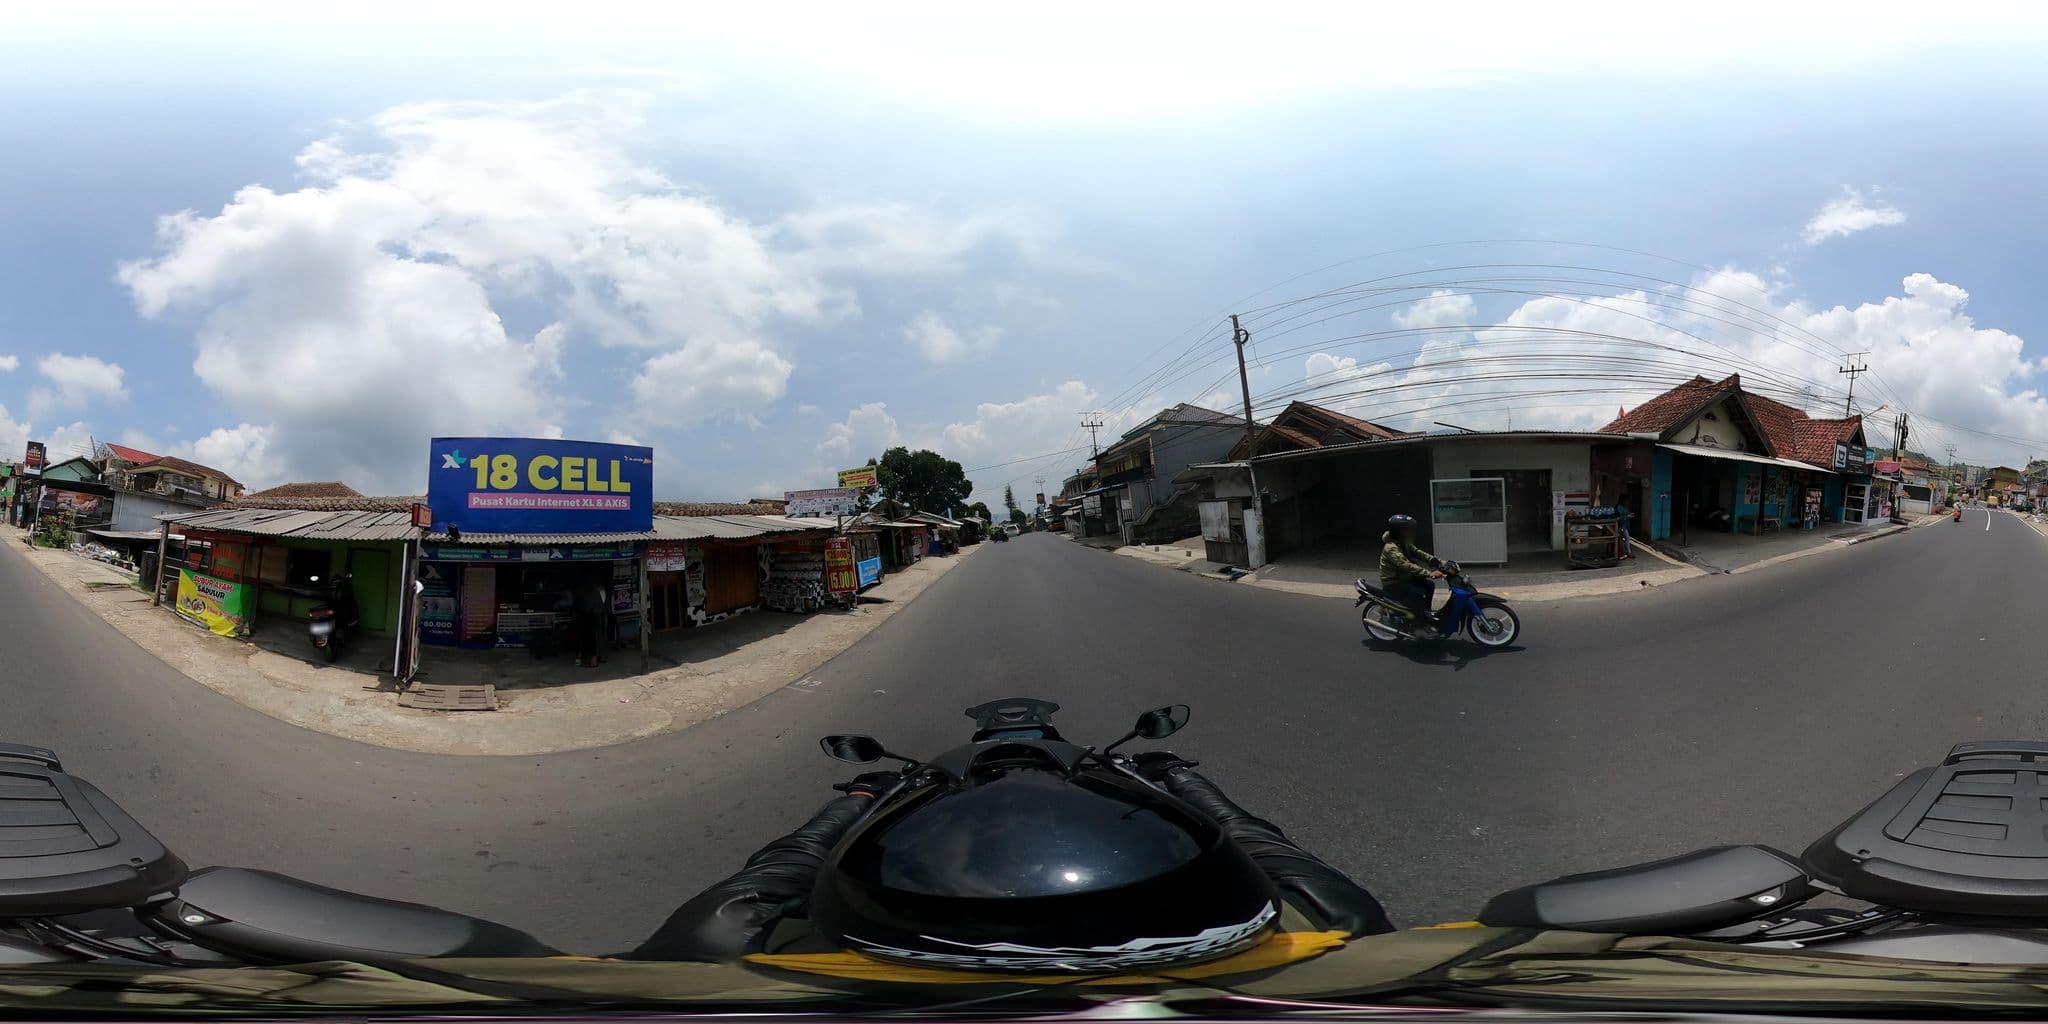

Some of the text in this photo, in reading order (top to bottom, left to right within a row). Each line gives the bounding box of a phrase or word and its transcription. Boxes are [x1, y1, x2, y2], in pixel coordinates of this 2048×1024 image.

[470, 454, 631, 492] 18 CELL
[472, 497, 504, 506] Pusat
[505, 497, 536, 506] Kartu
[537, 497, 582, 507] Internet
[582, 499, 595, 507] XL
[605, 499, 628, 508] AXIS
[197, 585, 225, 599] SADULUR
